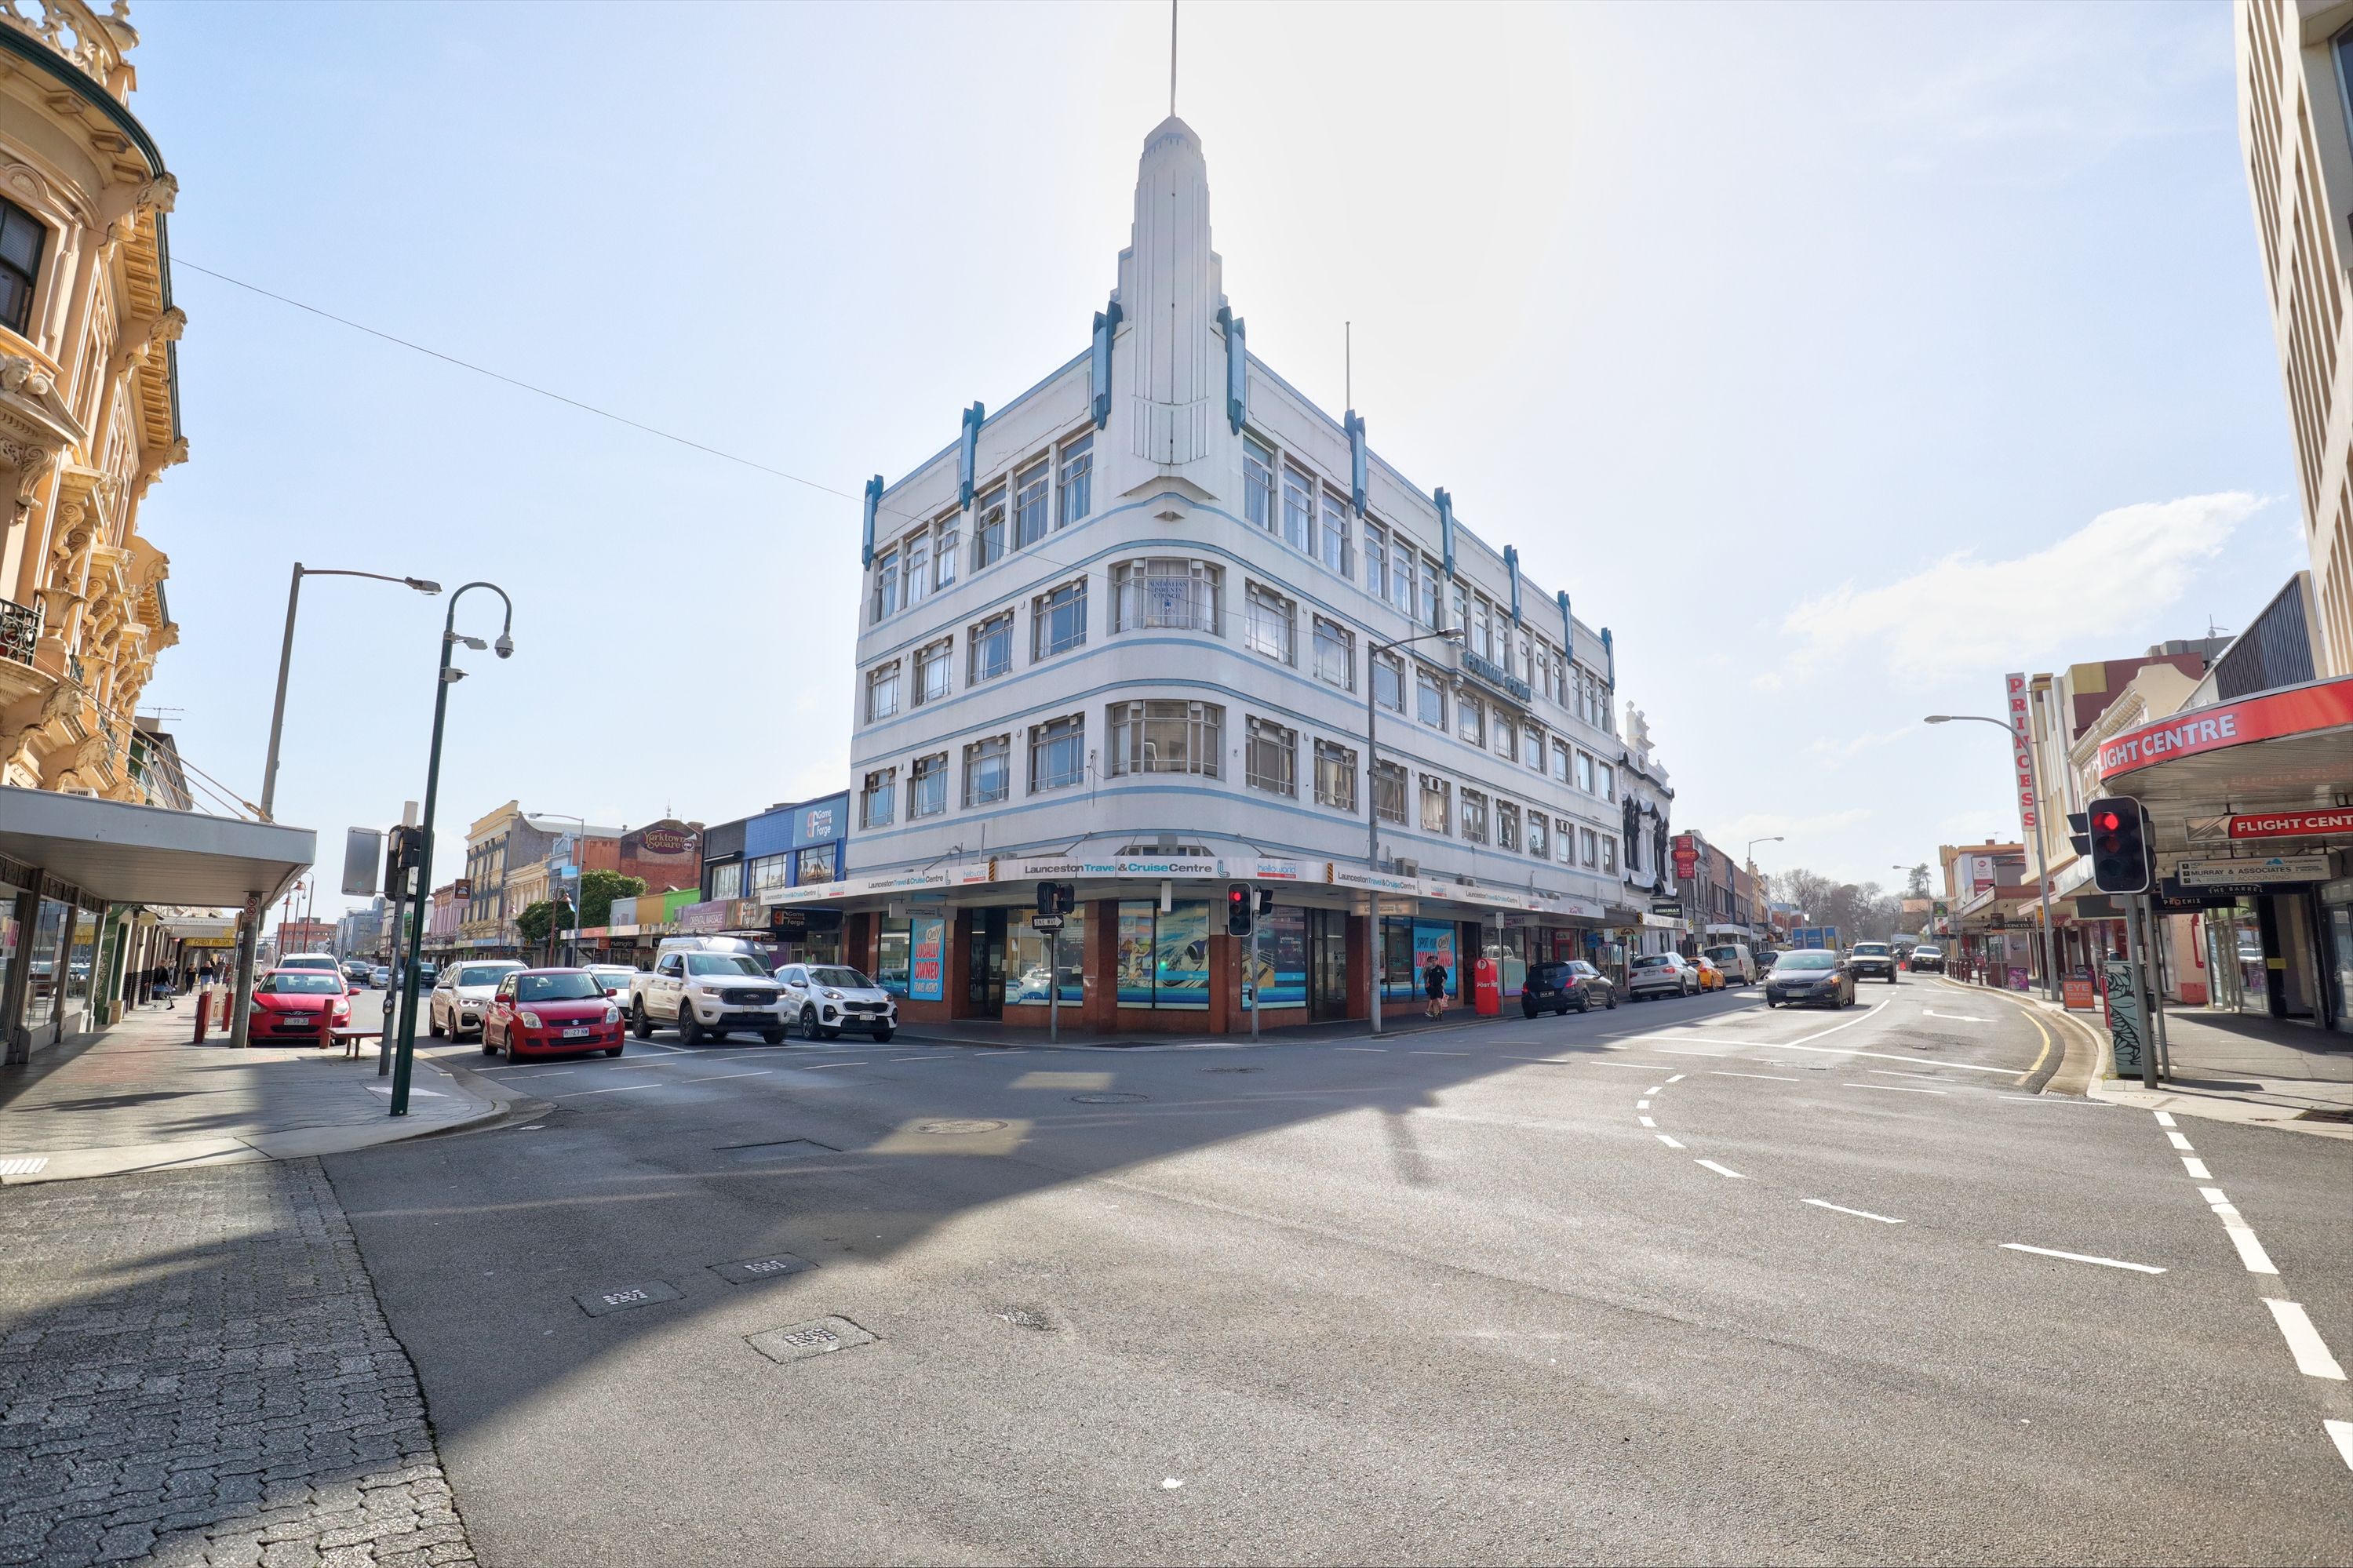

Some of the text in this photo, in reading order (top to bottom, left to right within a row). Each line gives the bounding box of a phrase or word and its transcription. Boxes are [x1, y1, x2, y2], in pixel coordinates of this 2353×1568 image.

[2141, 714, 2237, 756] CENTRE
[2009, 678, 2036, 827] PRINCESS
[818, 809, 832, 819] Game
[817, 825, 832, 837] Forge
[2237, 818, 2301, 832] FLIGHT
[644, 831, 687, 844] Yorktown
[647, 840, 681, 849] Square
[1025, 864, 1084, 874] Launceston
[1168, 864, 1212, 872] Centre
[2238, 866, 2292, 875] ASSOCIATES
[689, 914, 723, 926] ORIENTAL MASSAGE
[745, 916, 755, 925] Forge
[927, 926, 941, 940] Only
[1417, 937, 1429, 948] SUPPORT
[1438, 937, 1450, 949] Only
[915, 942, 941, 959] LOCALLY
[1437, 951, 1454, 967] OWNED
[914, 960, 939, 980] OWNED
[913, 981, 939, 994] TRAVEL AGENCY
[2066, 983, 2089, 991] EYE
